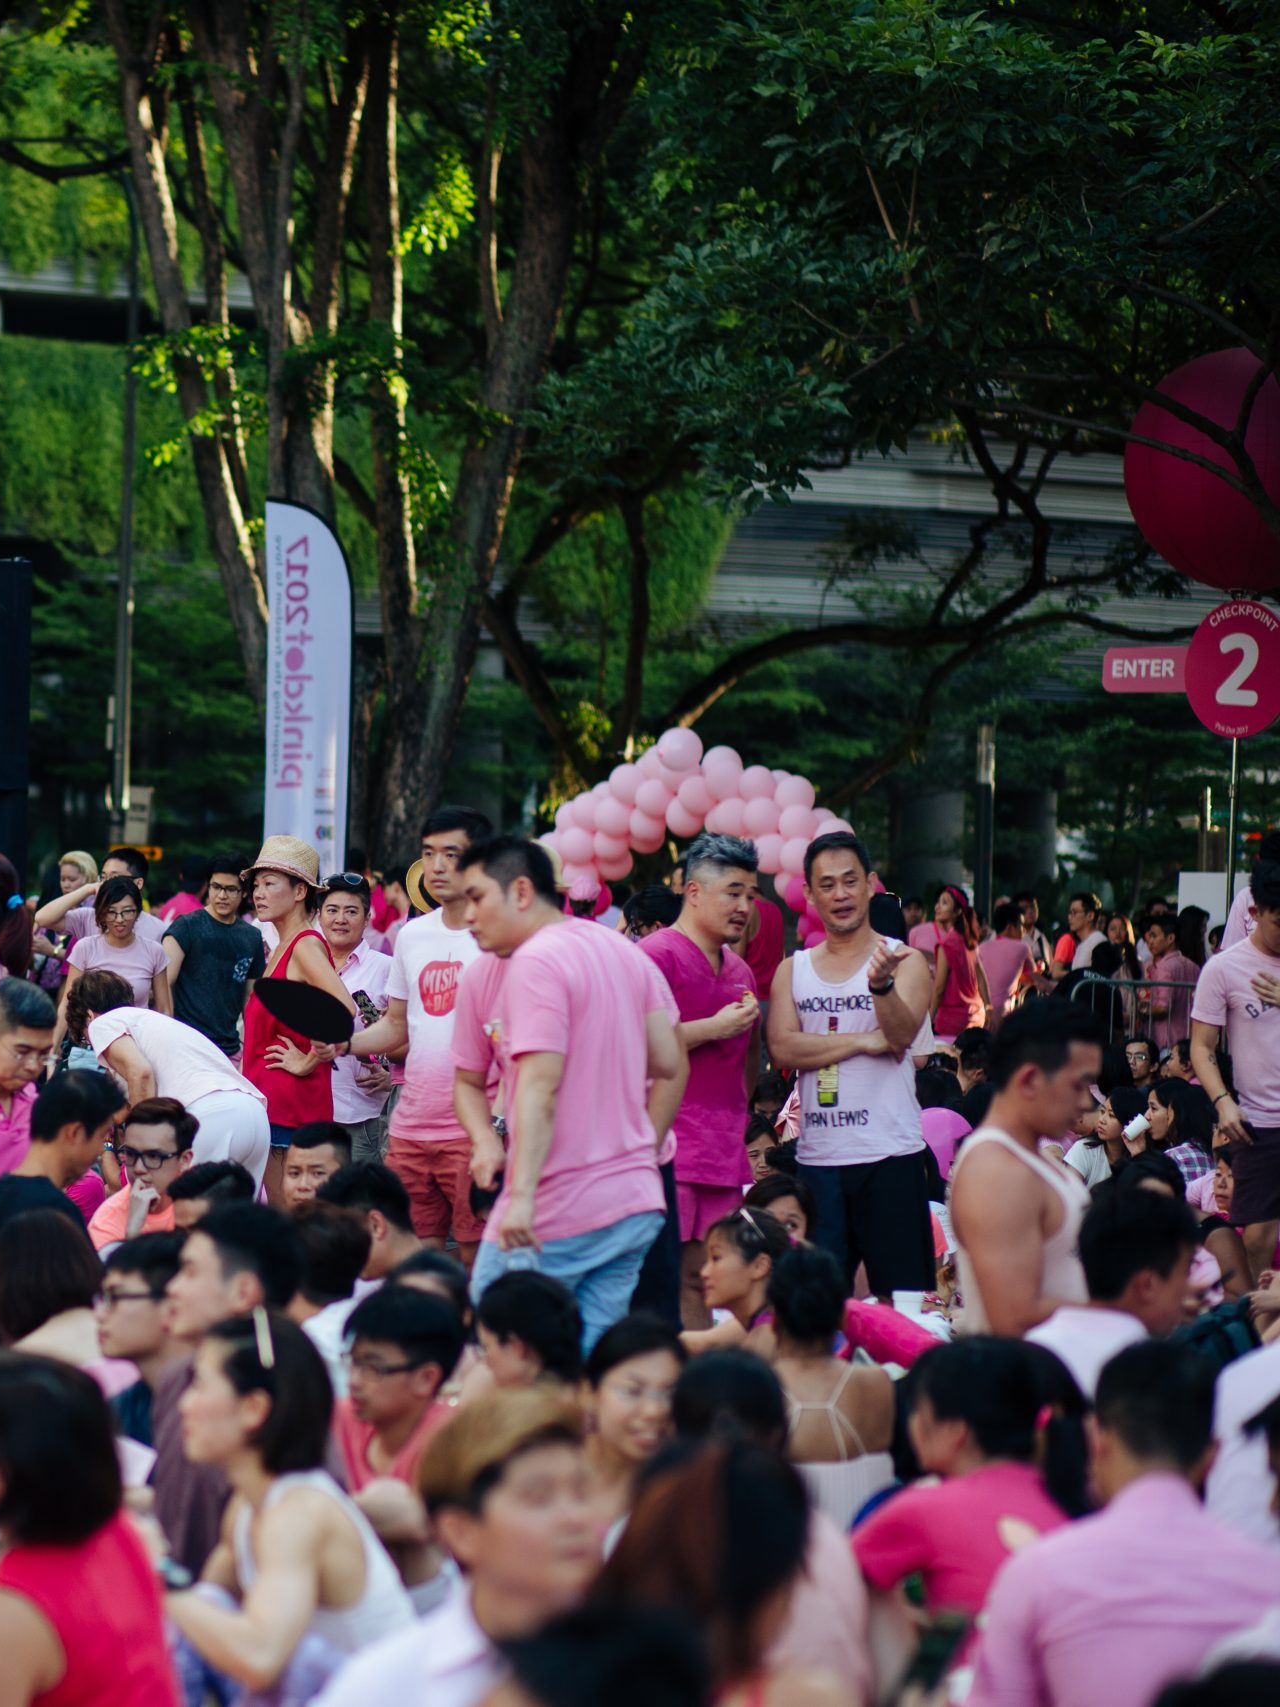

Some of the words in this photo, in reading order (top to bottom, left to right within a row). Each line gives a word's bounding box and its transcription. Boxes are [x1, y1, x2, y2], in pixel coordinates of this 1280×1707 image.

[1209, 604, 1279, 632] CHECKPOINT
[1111, 658, 1175, 679] ENTER
[1215, 632, 1260, 707] 2
[831, 1109, 869, 1128] LEWIS
